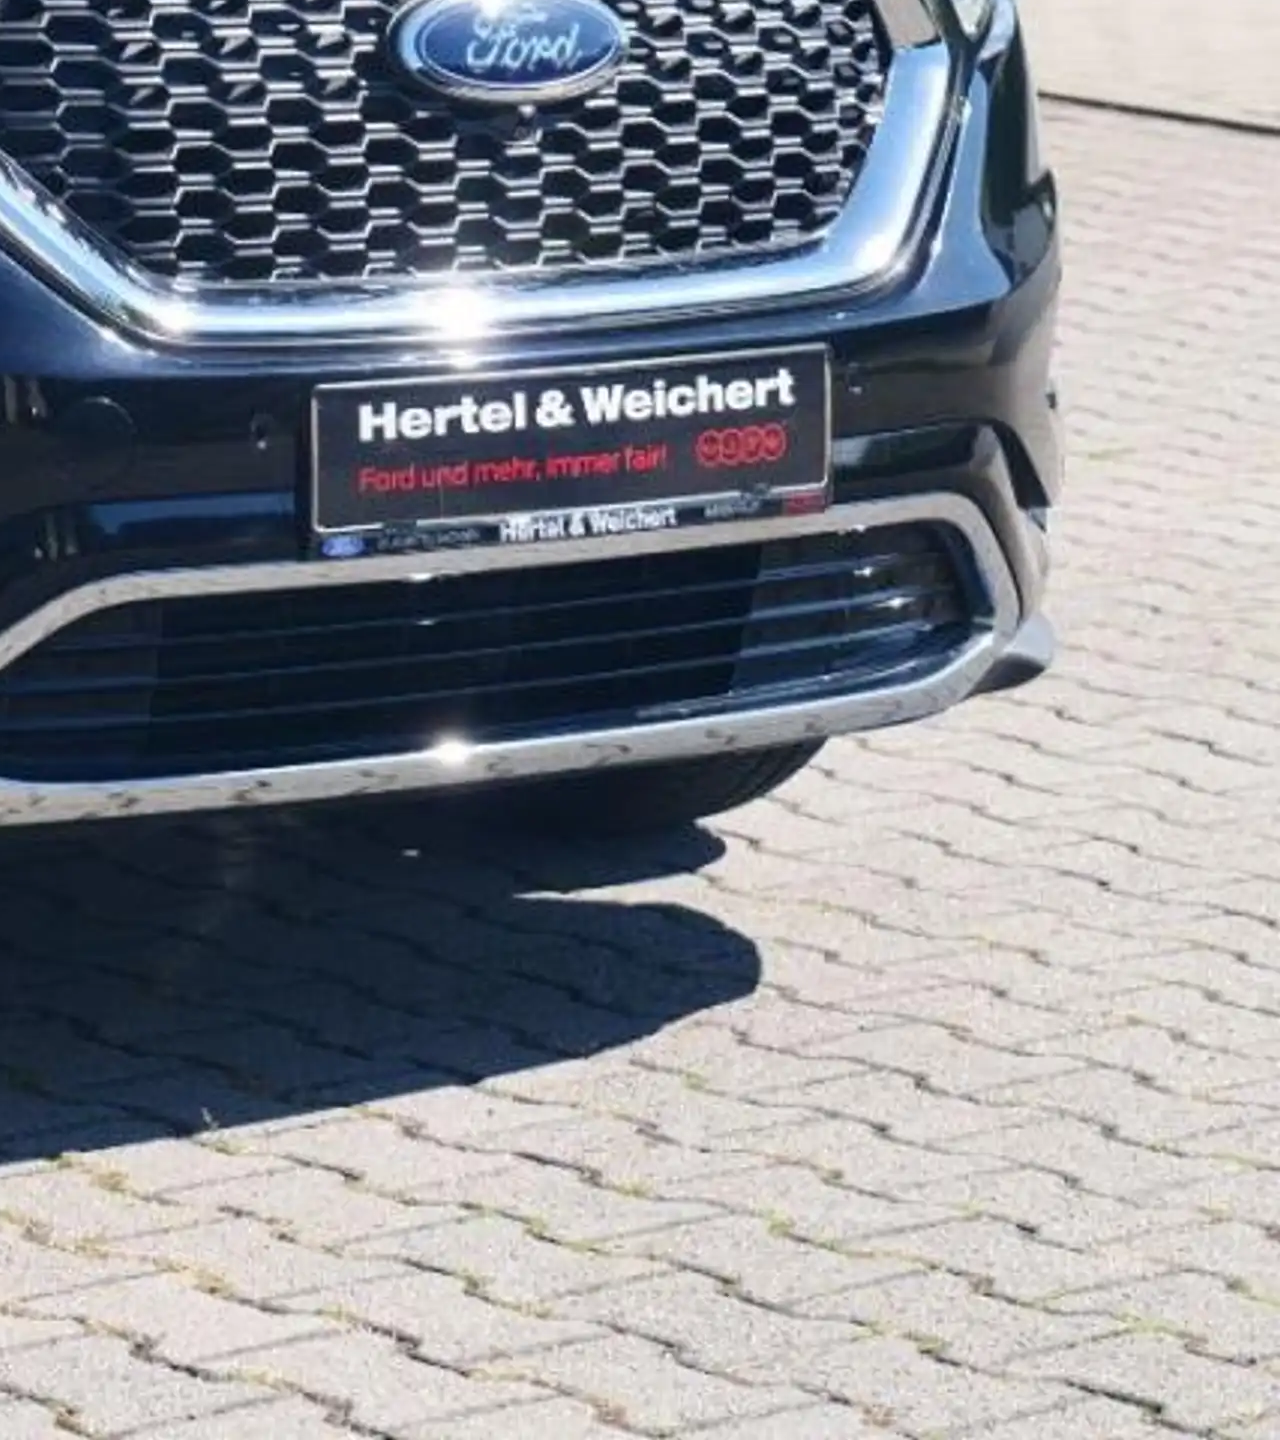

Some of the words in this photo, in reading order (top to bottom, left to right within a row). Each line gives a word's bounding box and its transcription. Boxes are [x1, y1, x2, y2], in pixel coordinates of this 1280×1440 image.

[464, 6, 586, 73] Ford
[358, 390, 527, 443] Hertel
[536, 389, 576, 428] &
[580, 367, 797, 424] Weichert
[357, 464, 416, 494] Ford
[421, 458, 469, 490] und
[473, 454, 540, 484] mehr,
[545, 450, 620, 478] immer
[624, 444, 669, 473] fair!
[498, 513, 566, 545] Hertel
[569, 511, 587, 539] &
[589, 506, 678, 536] Weichert
